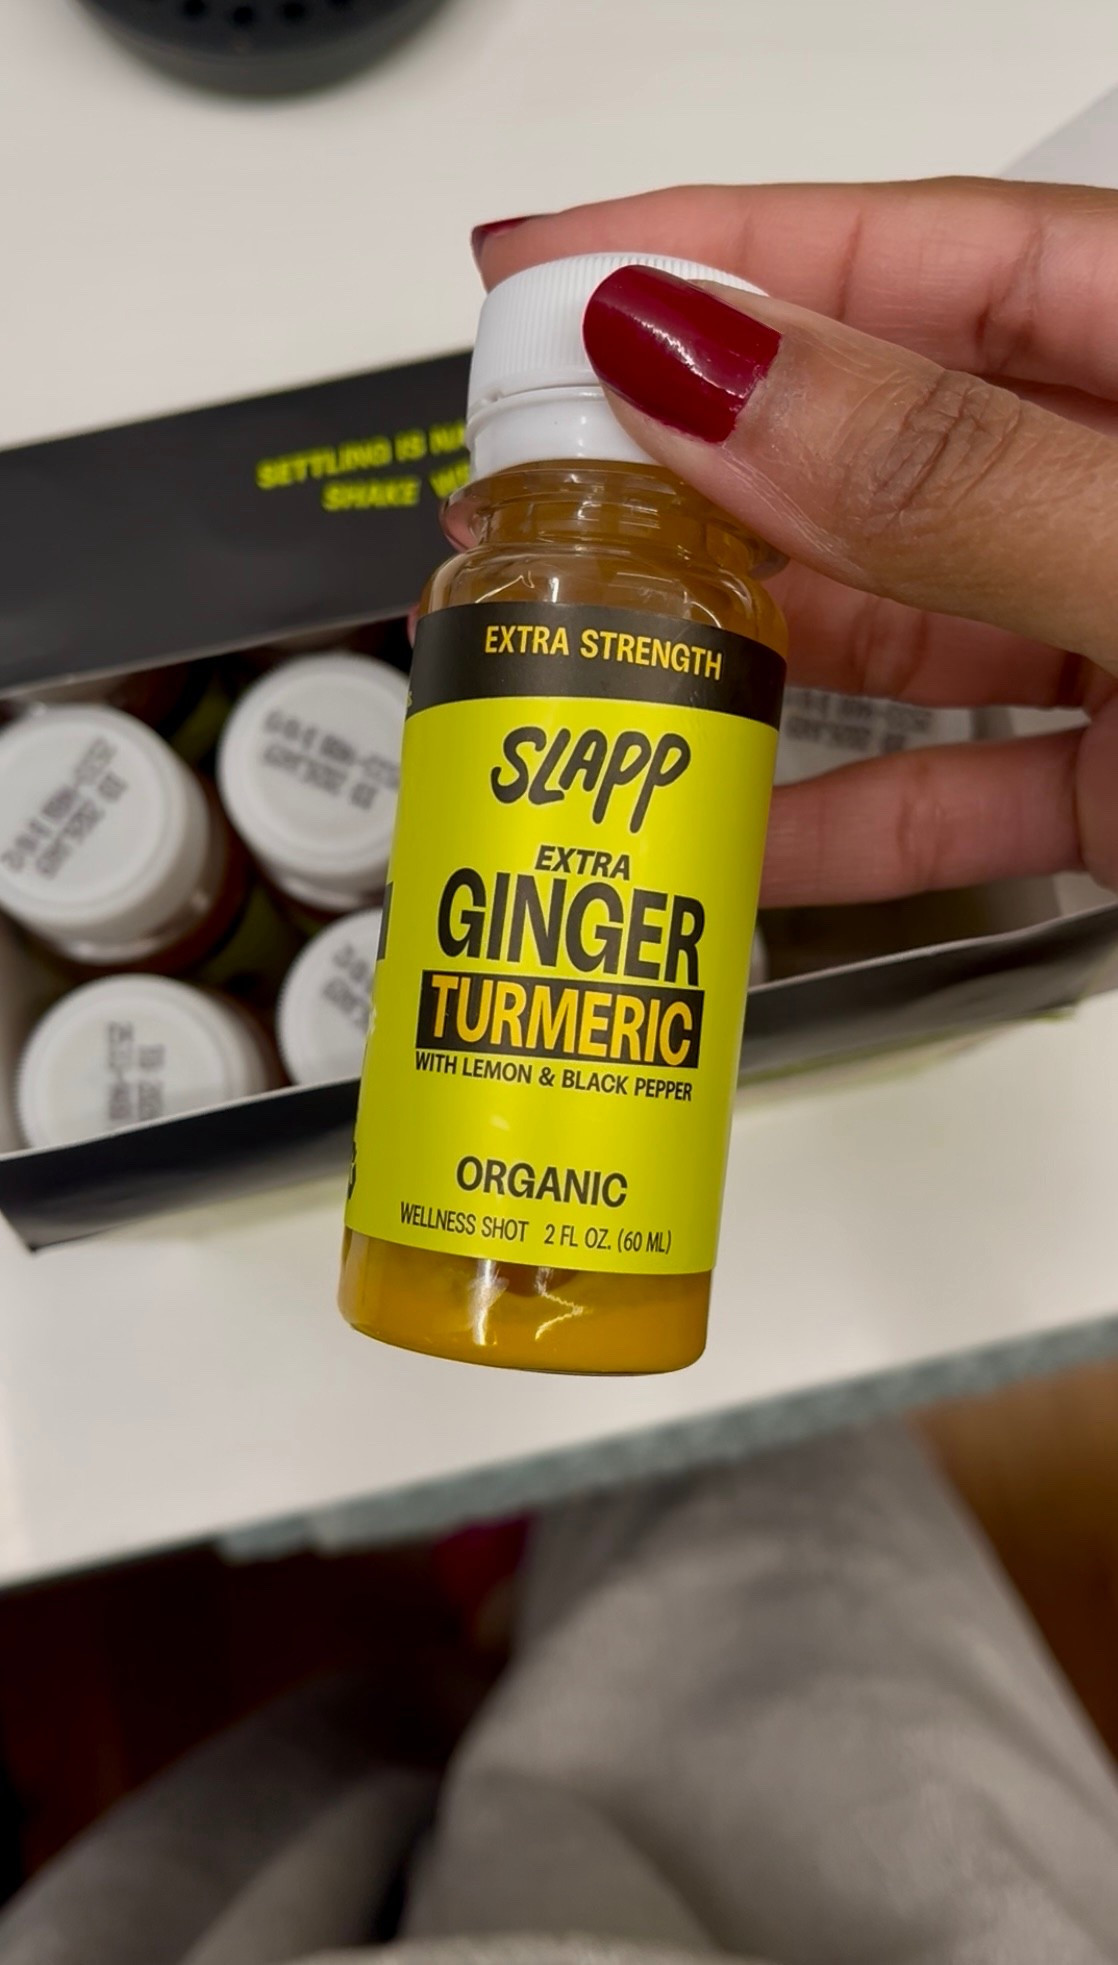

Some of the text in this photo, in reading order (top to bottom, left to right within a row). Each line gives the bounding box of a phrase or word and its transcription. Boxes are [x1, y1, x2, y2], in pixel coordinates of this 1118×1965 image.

[256, 436, 392, 490] SETTLING
[394, 427, 426, 461] IS
[323, 476, 420, 511] SHAKE
[485, 625, 722, 680] EXTRA STRENGTH
[490, 726, 691, 833] SLAPP
[535, 844, 631, 881] EXTRA
[437, 868, 706, 986] GINGER
[431, 974, 693, 1066] TURMERIC
[415, 1051, 693, 1101] WITH LEMON & BLACK PEPPER
[456, 1156, 628, 1208] ORGANIC
[401, 1201, 671, 1254] WELLNESS SHOT 2 FL OZ. (60 ML)
